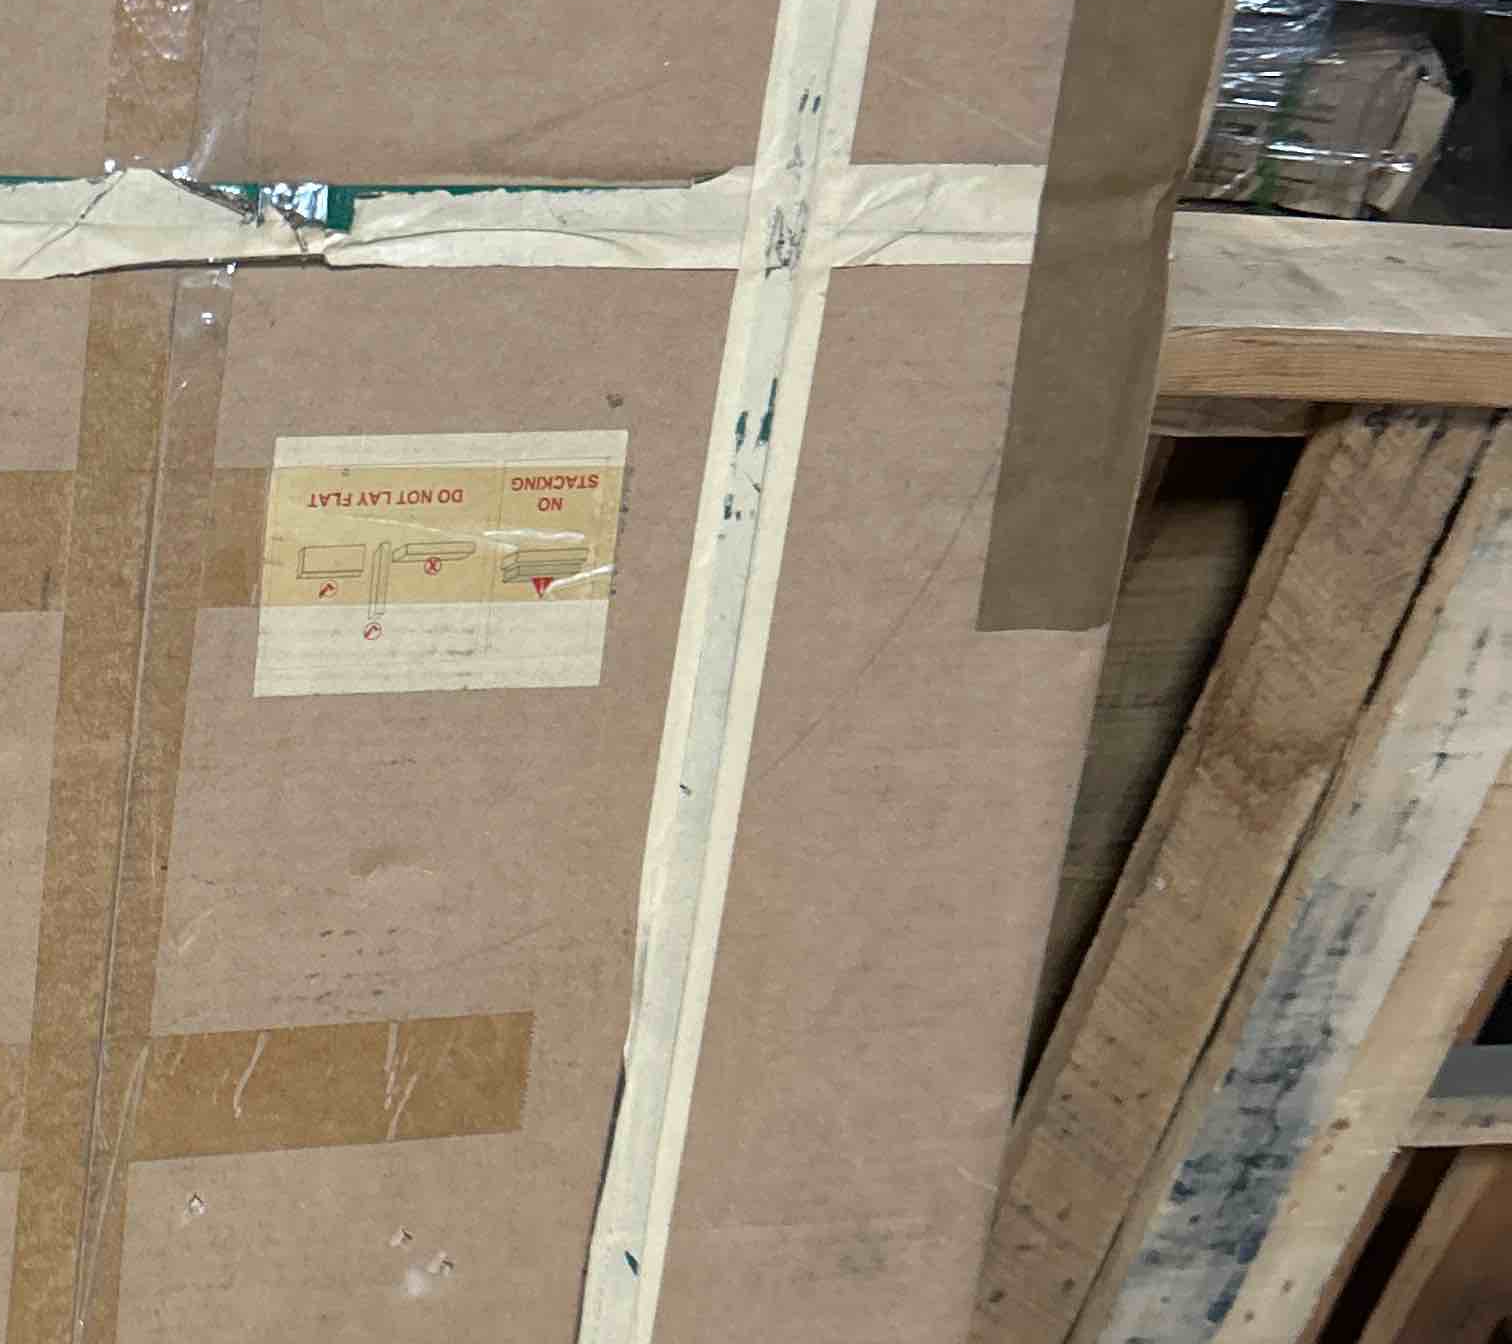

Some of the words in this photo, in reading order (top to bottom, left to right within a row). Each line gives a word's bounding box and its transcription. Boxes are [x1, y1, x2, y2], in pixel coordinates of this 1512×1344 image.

[511, 474, 600, 492] STACKING
[307, 493, 351, 508] FLAT
[354, 491, 391, 506] LAY
[395, 490, 433, 505] NOT
[437, 488, 464, 503] DO
[537, 497, 563, 512] NO
